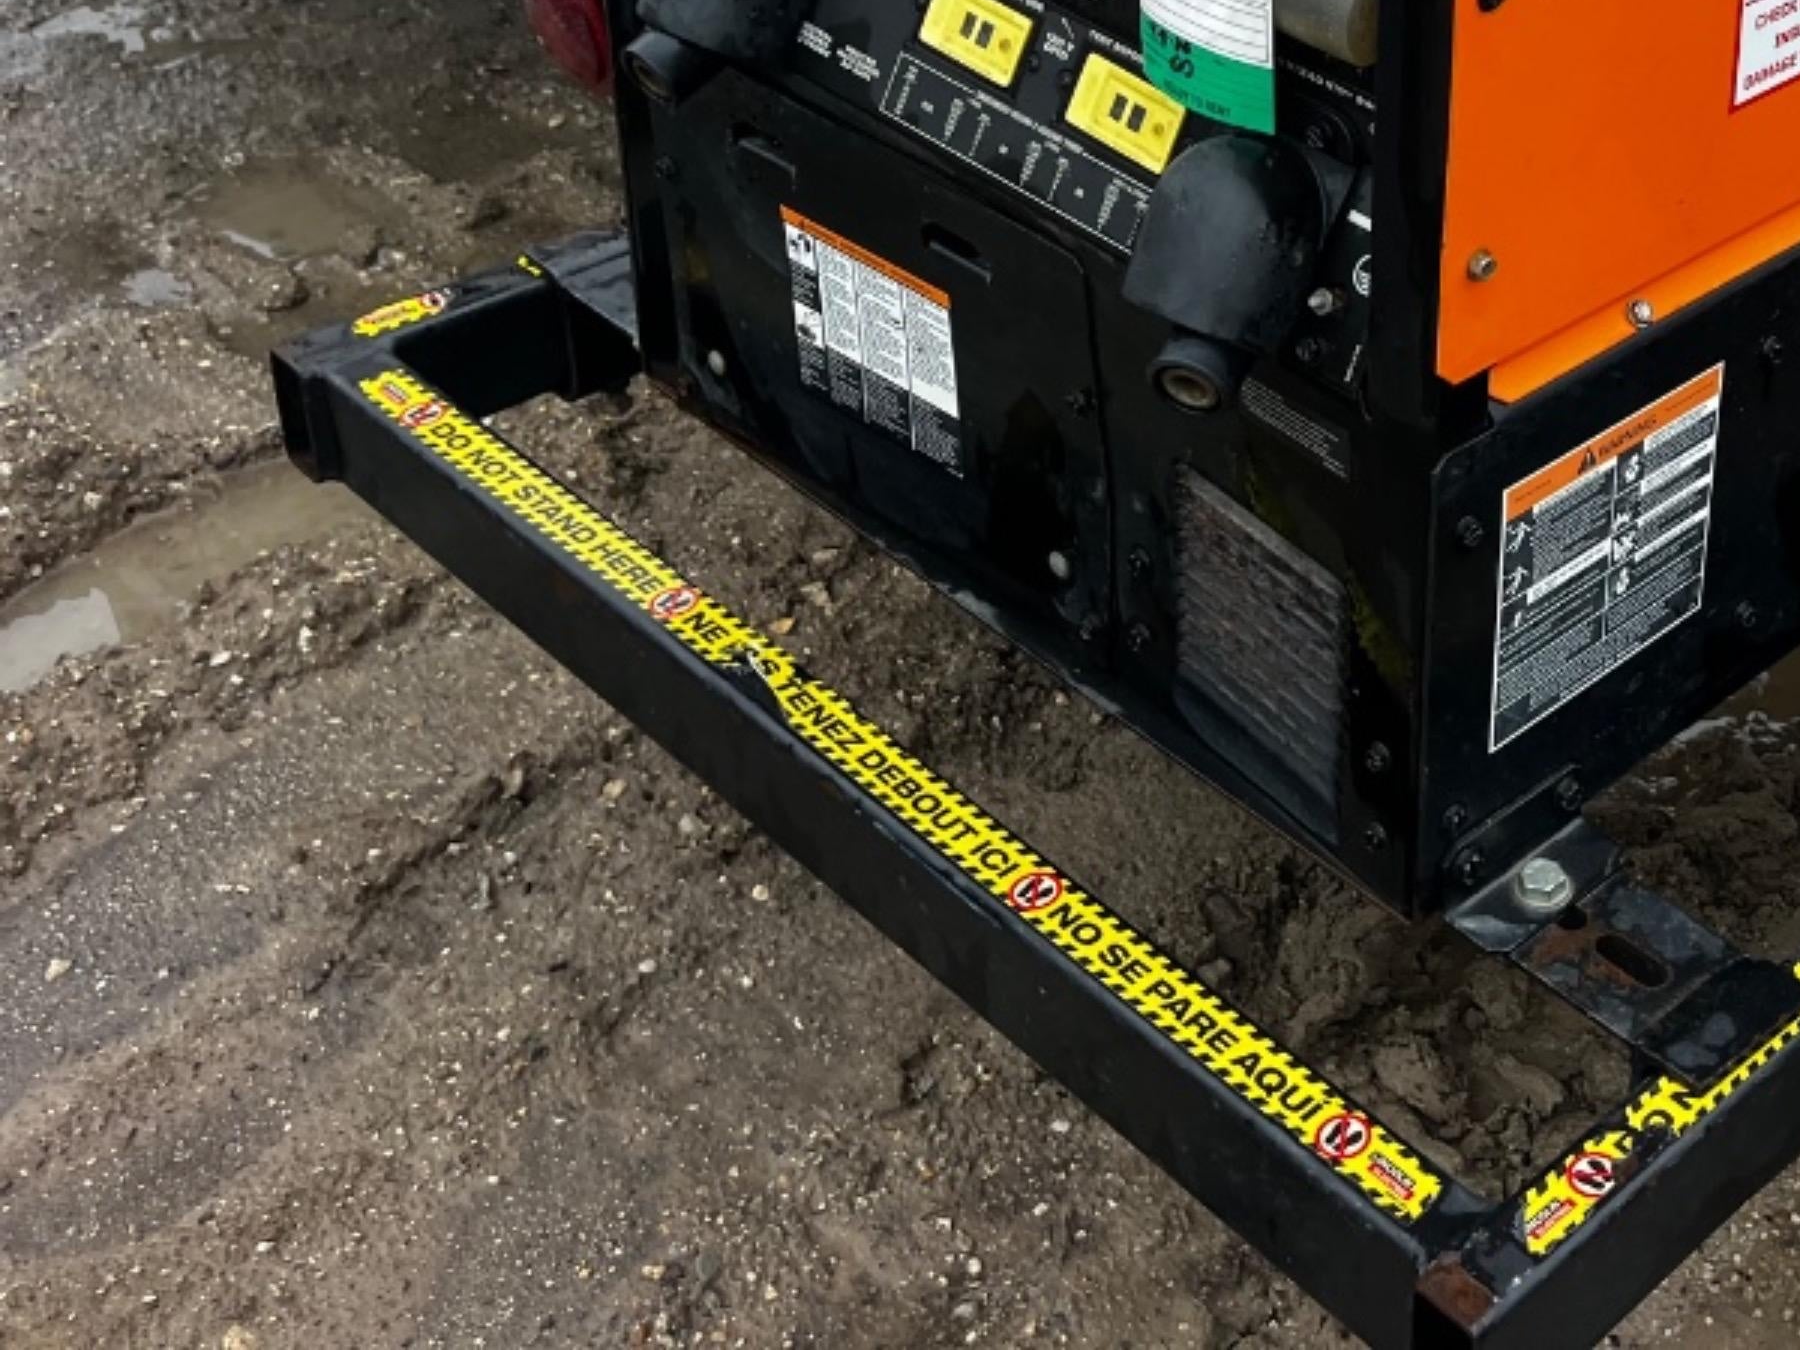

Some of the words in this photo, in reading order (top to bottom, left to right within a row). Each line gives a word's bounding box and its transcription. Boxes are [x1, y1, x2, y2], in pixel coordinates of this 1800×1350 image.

[429, 421, 471, 450] DO
[466, 445, 517, 489] NOT
[511, 486, 597, 547] STAND
[591, 542, 664, 594] HERE
[684, 611, 724, 641] NE
[778, 675, 864, 755] TENEZ
[856, 748, 980, 840] DEBOUT
[972, 836, 1019, 880] ICI
[1047, 903, 1104, 947] NO
[1099, 942, 1152, 985] SE
[1145, 980, 1234, 1052] PARE
